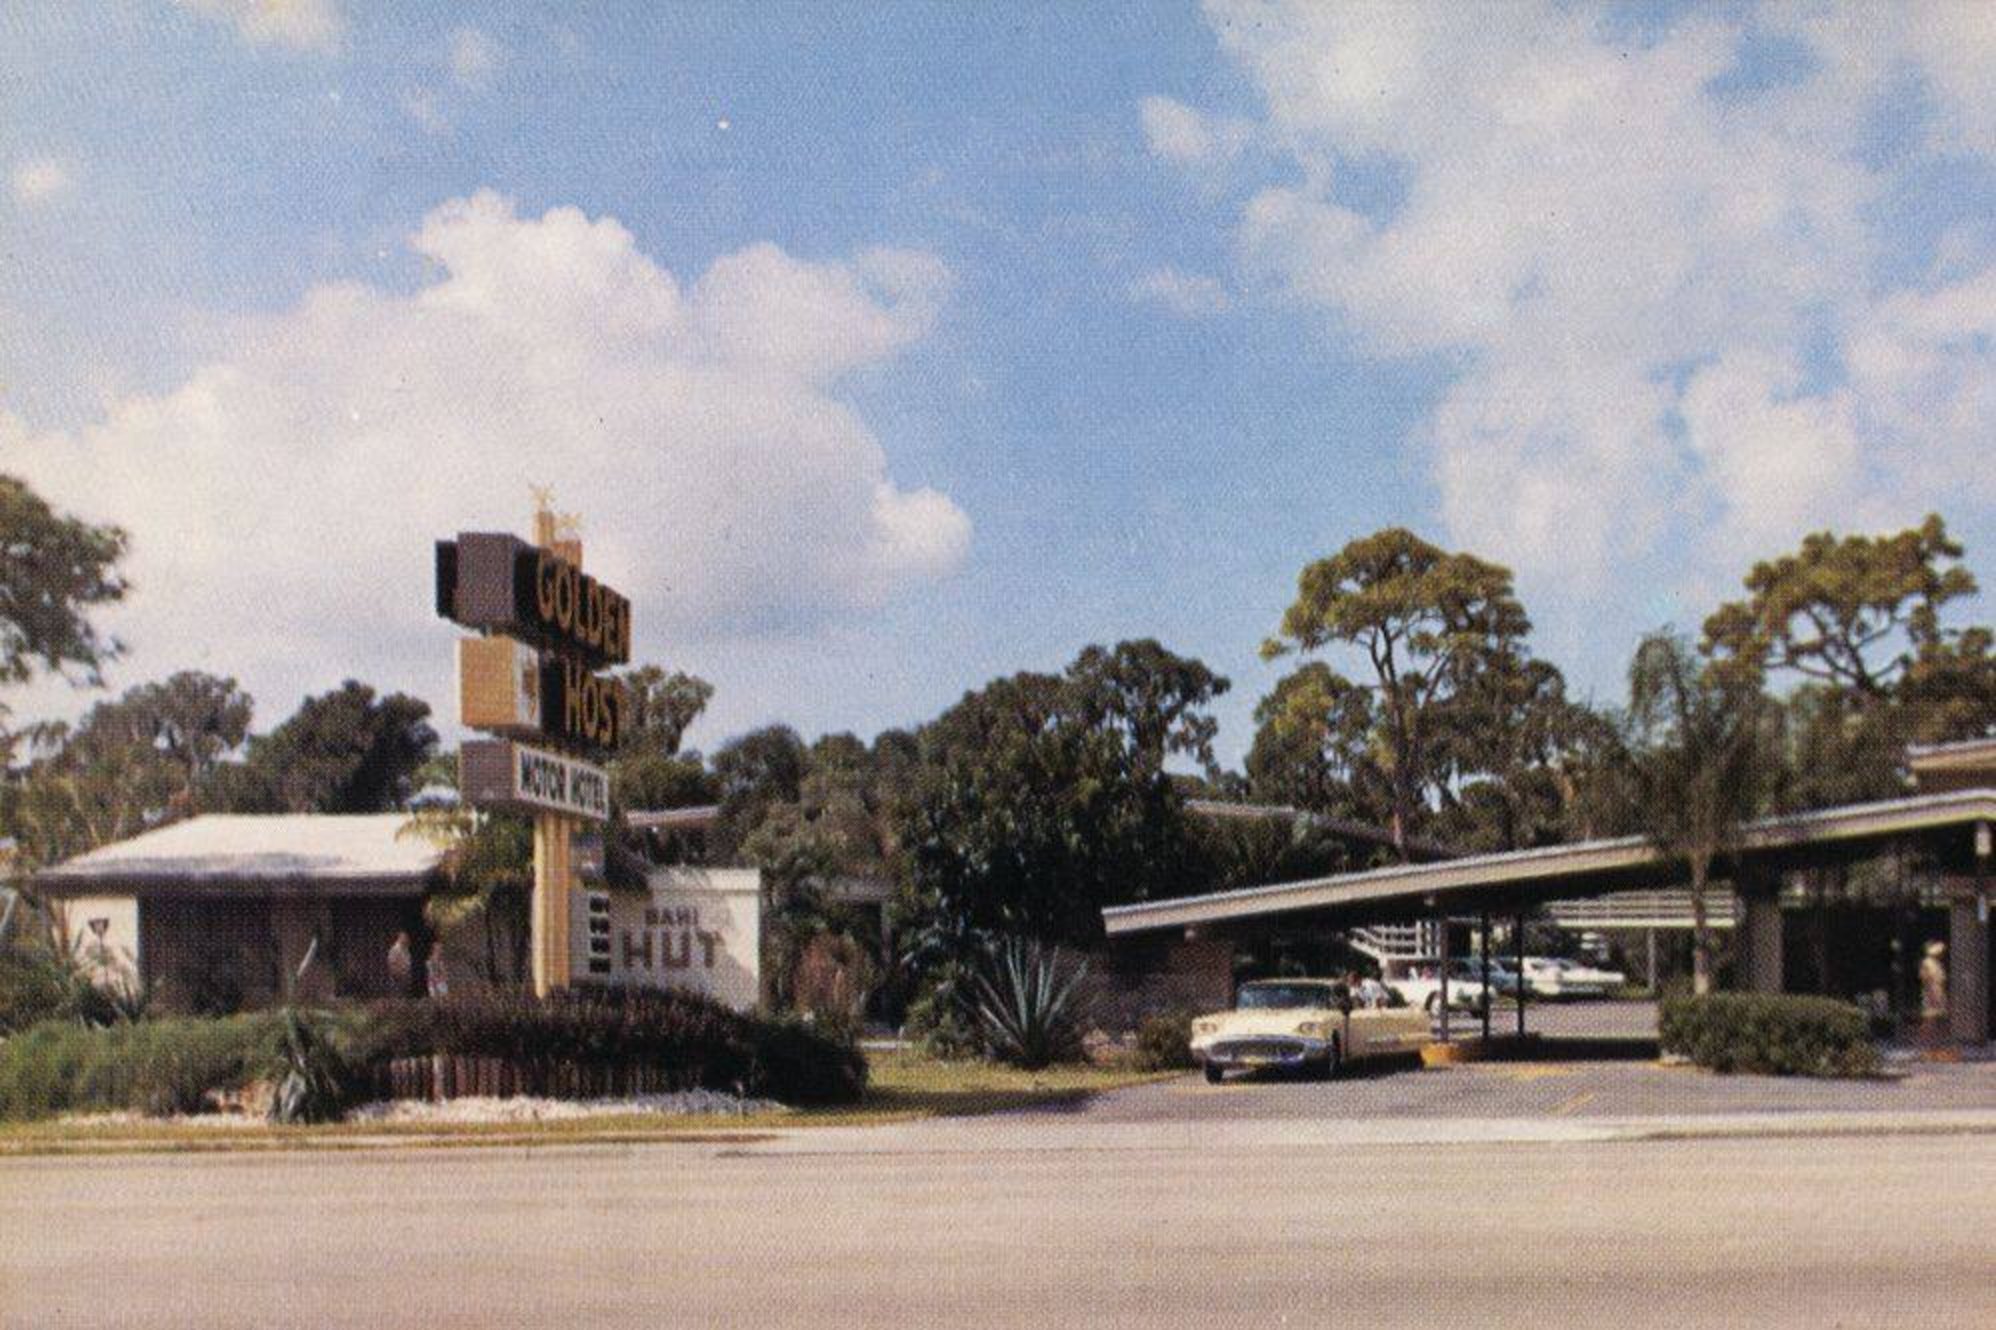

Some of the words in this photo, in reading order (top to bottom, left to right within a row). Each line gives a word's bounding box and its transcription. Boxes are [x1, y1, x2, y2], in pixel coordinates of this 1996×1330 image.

[537, 553, 630, 661] GOLDEN
[521, 750, 567, 803] MOTOR
[570, 766, 607, 815] HOTEL
[623, 929, 726, 969] HUT
